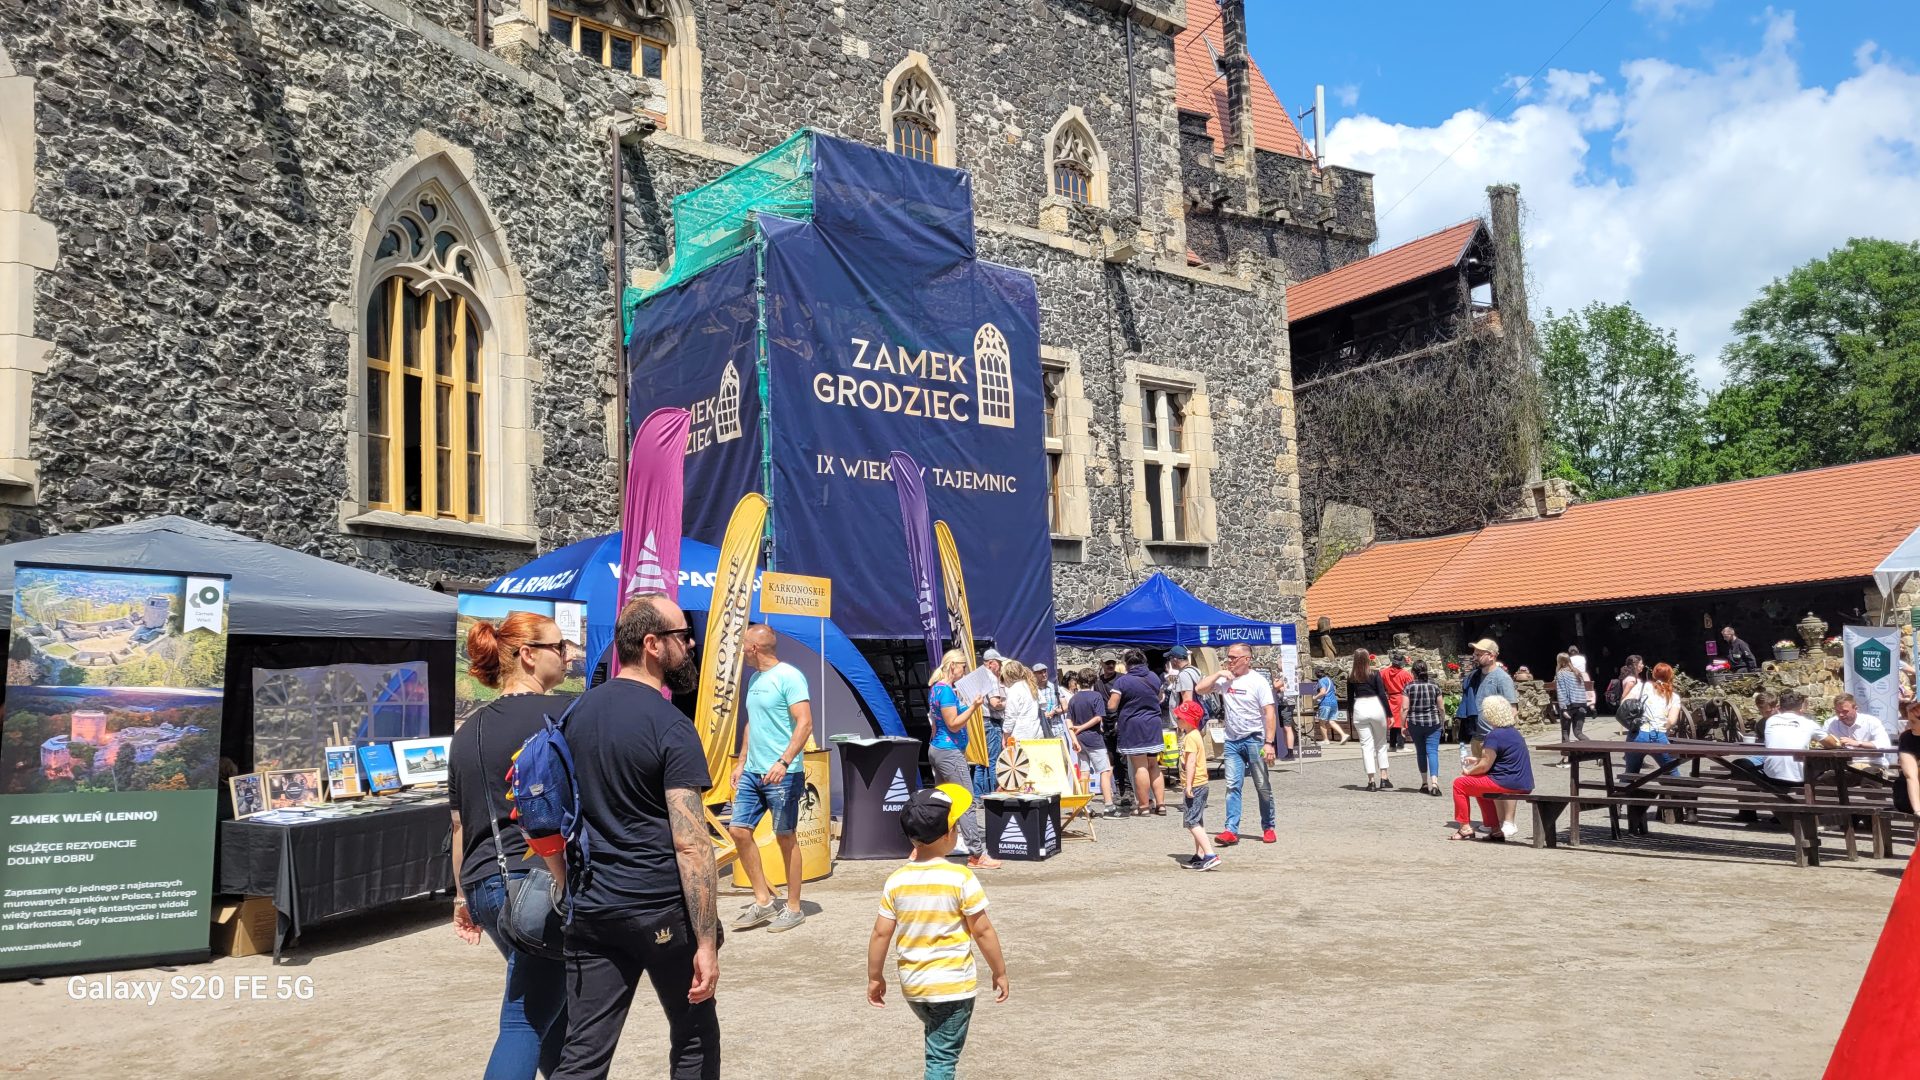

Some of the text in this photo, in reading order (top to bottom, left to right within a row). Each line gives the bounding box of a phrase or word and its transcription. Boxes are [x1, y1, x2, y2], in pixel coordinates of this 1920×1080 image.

[851, 337, 969, 385] ZAMEK
[813, 372, 970, 422] GRODZIEC
[816, 454, 835, 474] IX
[932, 467, 1017, 493] TAJEMNIC
[768, 582, 826, 597] KARKONOSKIE
[775, 595, 819, 607] TAJEMNICE
[1216, 626, 1265, 641] ŚWIERZAWA
[1862, 655, 1881, 668] SIEĆ
[10, 811, 158, 825] ZAMEK WLEŃ (LENNO)
[8, 839, 137, 854] KSIĄŻĘCE REZYDENCJE
[7, 853, 95, 866] DOLINY BOBRU
[4, 887, 63, 898] Zapraszamy
[64, 885, 78, 893] do
[78, 883, 118, 894] jednego
[127, 879, 183, 890] najstarszych
[3, 897, 67, 908] murowanych
[68, 894, 110, 904] zamków
[121, 892, 153, 901] Polsce,
[161, 889, 197, 898] którego
[2, 899, 189, 920] wieży roztaczają się fantastyczne widoki
[1, 923, 14, 931] na
[16, 919, 75, 930] Karkonosze,
[76, 917, 100, 926] Góry
[101, 912, 155, 923] Kaczawskie
